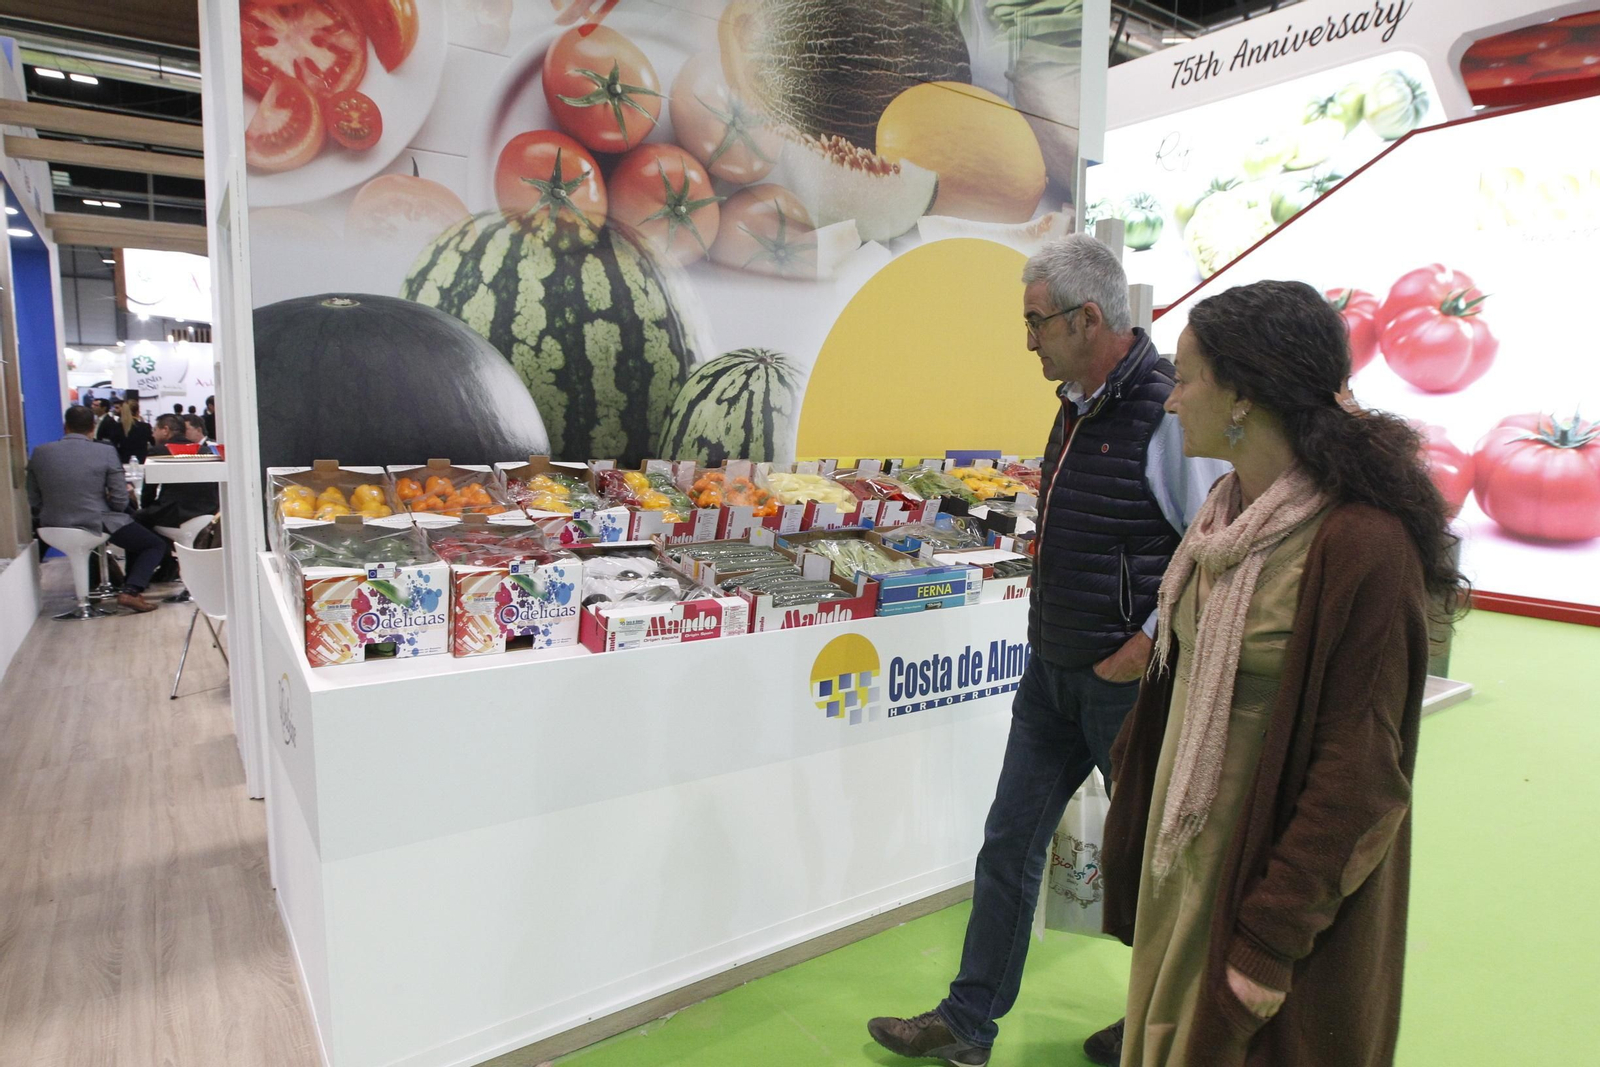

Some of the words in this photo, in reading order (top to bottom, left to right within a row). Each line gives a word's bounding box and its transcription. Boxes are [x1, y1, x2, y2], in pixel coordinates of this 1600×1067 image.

[1171, 50, 1224, 89] 75th
[1229, 0, 1413, 72] Anniversary
[917, 583, 952, 598] FERNA
[644, 611, 718, 638] Mando
[781, 604, 853, 630] Mando
[889, 654, 953, 702] Costa
[957, 645, 983, 689] de
